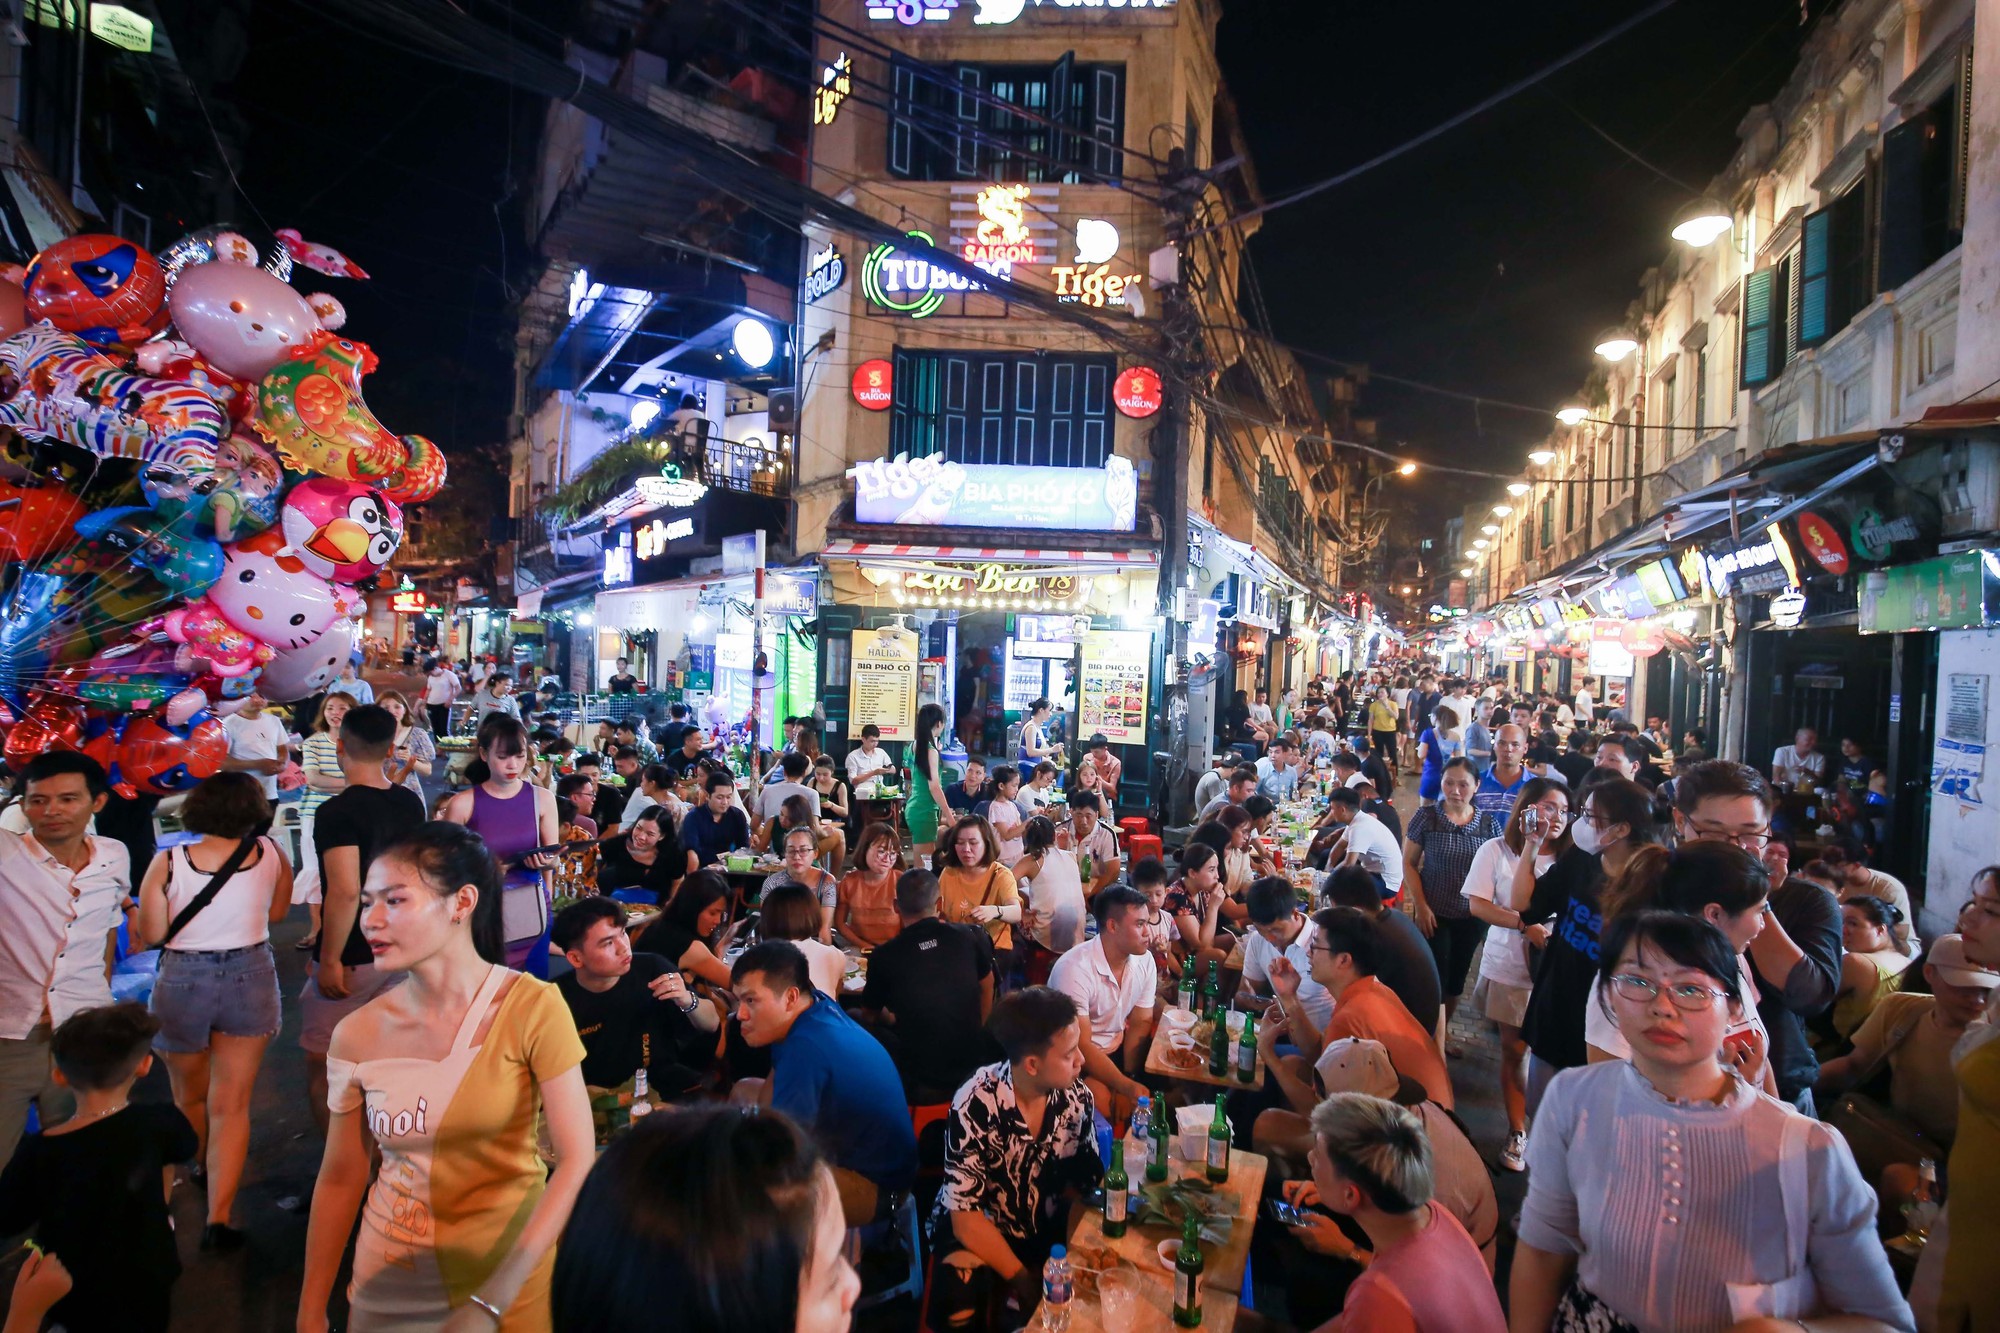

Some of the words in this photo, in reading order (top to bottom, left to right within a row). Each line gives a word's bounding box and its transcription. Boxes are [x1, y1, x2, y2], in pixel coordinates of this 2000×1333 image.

[964, 245, 1034, 262] SAIGON
[805, 259, 842, 303] BOLD
[860, 391, 891, 401] SAIGON
[1120, 398, 1153, 409] SAIGON
[846, 450, 944, 499] Tiger
[964, 482, 1003, 502] BIA
[868, 648, 902, 658] HALIDA
[857, 662, 872, 670] BIA
[1088, 663, 1103, 671] BIA
